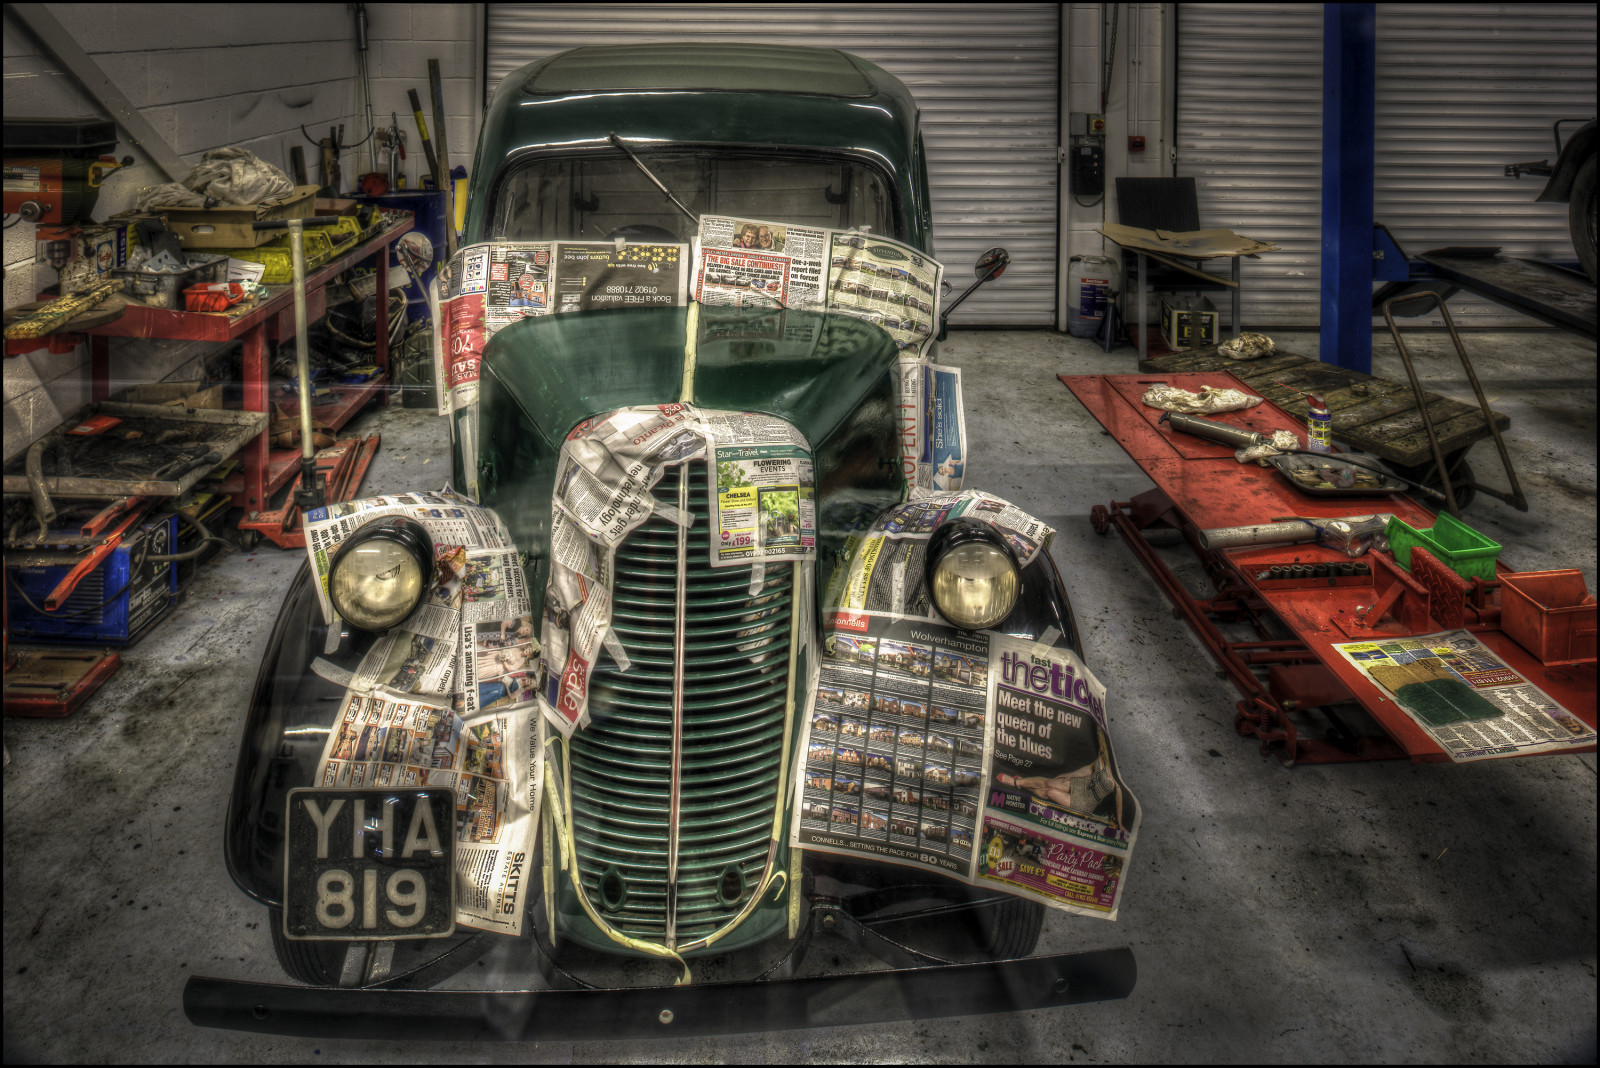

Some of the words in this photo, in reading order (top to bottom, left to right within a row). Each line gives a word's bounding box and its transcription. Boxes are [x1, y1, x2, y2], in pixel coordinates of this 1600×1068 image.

[720, 256, 730, 264] BIG
[730, 258, 746, 266] SALE
[747, 259, 784, 270] CONTINUES!!
[792, 258, 822, 267] One-a-week
[790, 280, 820, 290] marriages
[800, 274, 818, 282] forced
[634, 286, 658, 294] 01902
[663, 404, 682, 417] 0%
[633, 420, 674, 446] Picanto
[936, 424, 944, 449] She's
[717, 450, 732, 458] Star
[738, 448, 759, 457] Travel
[754, 459, 792, 467] FLOWERING
[599, 478, 634, 525] technology
[610, 517, 626, 535] gets
[732, 536, 751, 547] £199
[510, 552, 518, 567] Sweet
[504, 568, 514, 598] fundraisers
[512, 568, 521, 588] success
[462, 626, 472, 647] Lisa's
[910, 630, 988, 654] Wolverhampton
[465, 648, 474, 688] amazing
[1031, 655, 1051, 668] fast
[437, 666, 454, 694] carpets
[564, 658, 586, 712] sale
[466, 689, 476, 711] f-eat
[998, 690, 1031, 713] Meet
[1034, 700, 1054, 720] the
[1057, 710, 1082, 729] new
[530, 718, 537, 733] We
[998, 712, 1035, 735] queen
[1038, 722, 1052, 739] of
[996, 728, 1016, 748] the
[1020, 735, 1052, 759] blues
[995, 750, 1008, 760] See
[1008, 754, 1024, 767] Page
[1024, 760, 1033, 768] 27
[1006, 794, 1022, 802] NATIVE
[1006, 800, 1026, 810] MONSTER
[303, 800, 444, 858] YHA
[1077, 830, 1093, 839] Express
[1097, 834, 1105, 842] Star
[812, 836, 848, 847] CONNELLS...
[850, 842, 875, 851] SETTING
[876, 846, 888, 854] THE
[889, 848, 905, 857] PACE
[906, 851, 919, 859] FOR
[920, 854, 937, 864] 80
[939, 859, 958, 870] YEARS
[989, 846, 1001, 857] £13
[1048, 844, 1078, 871] Party
[1080, 851, 1103, 871] Pack
[502, 851, 514, 878] ESTATE
[998, 860, 1013, 872] SALE
[1020, 864, 1036, 875] SAVE
[503, 852, 526, 916] SKITTS
[315, 869, 426, 929] 819
[495, 881, 506, 914] AGENTS
